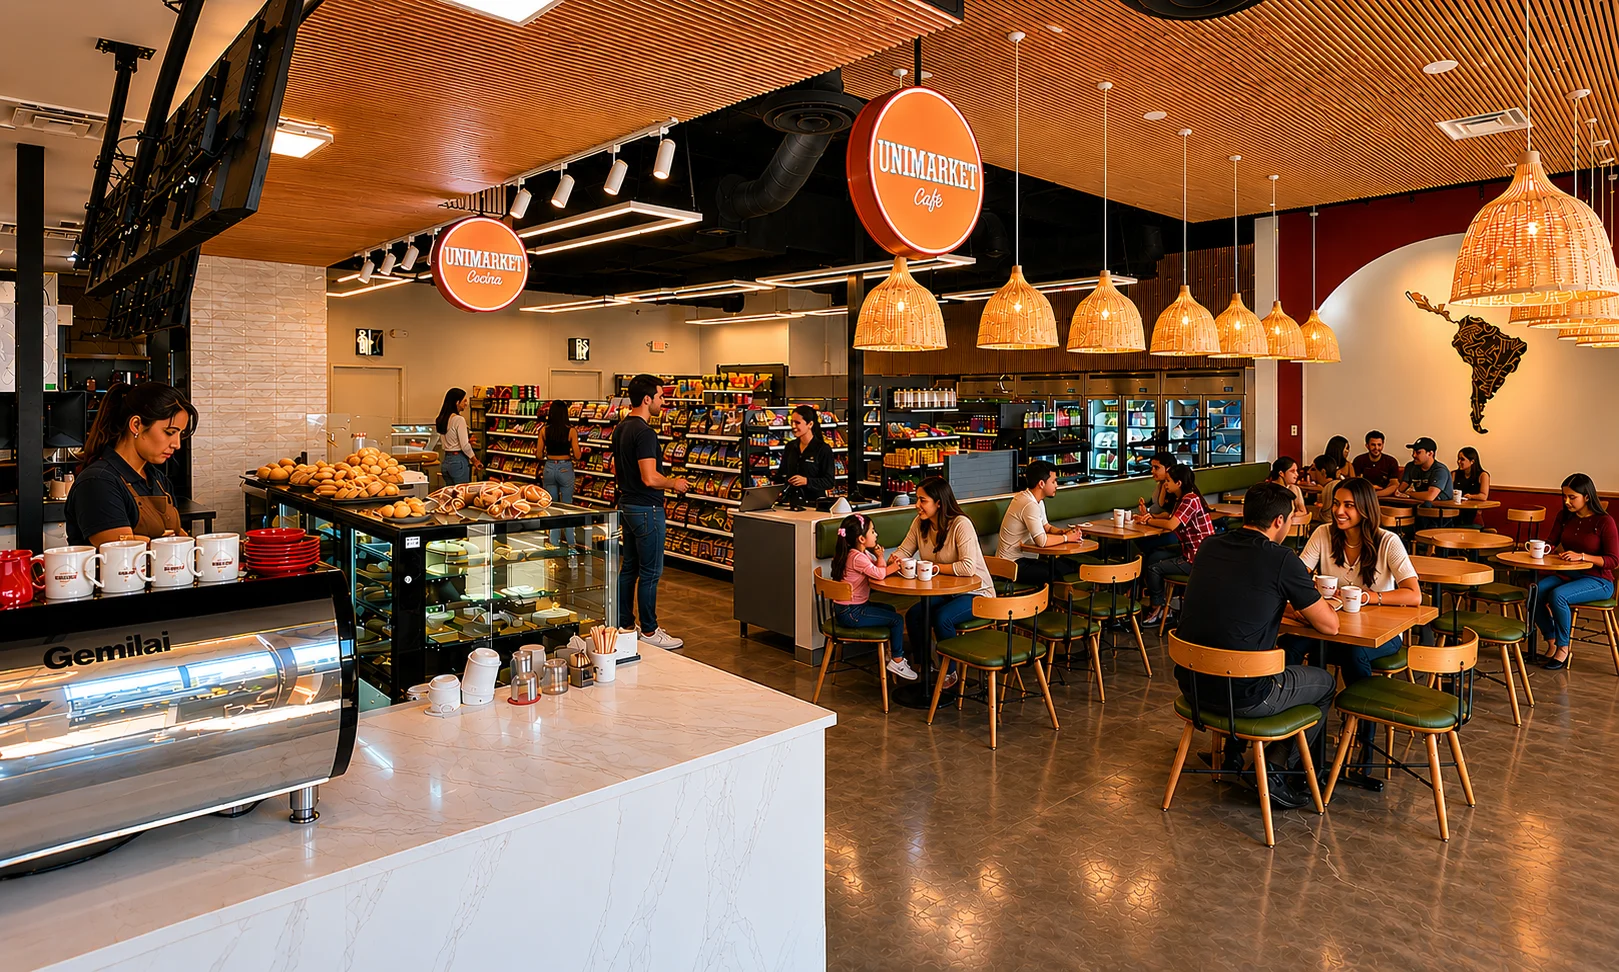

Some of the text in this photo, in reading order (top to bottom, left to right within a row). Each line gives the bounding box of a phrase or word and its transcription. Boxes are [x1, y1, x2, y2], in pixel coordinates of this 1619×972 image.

[877, 139, 977, 191] UNIMARKET
[914, 187, 943, 212] Café
[445, 247, 523, 272] UNIMARKET
[467, 270, 502, 285] Cocina
[43, 631, 171, 669] Gemilai
